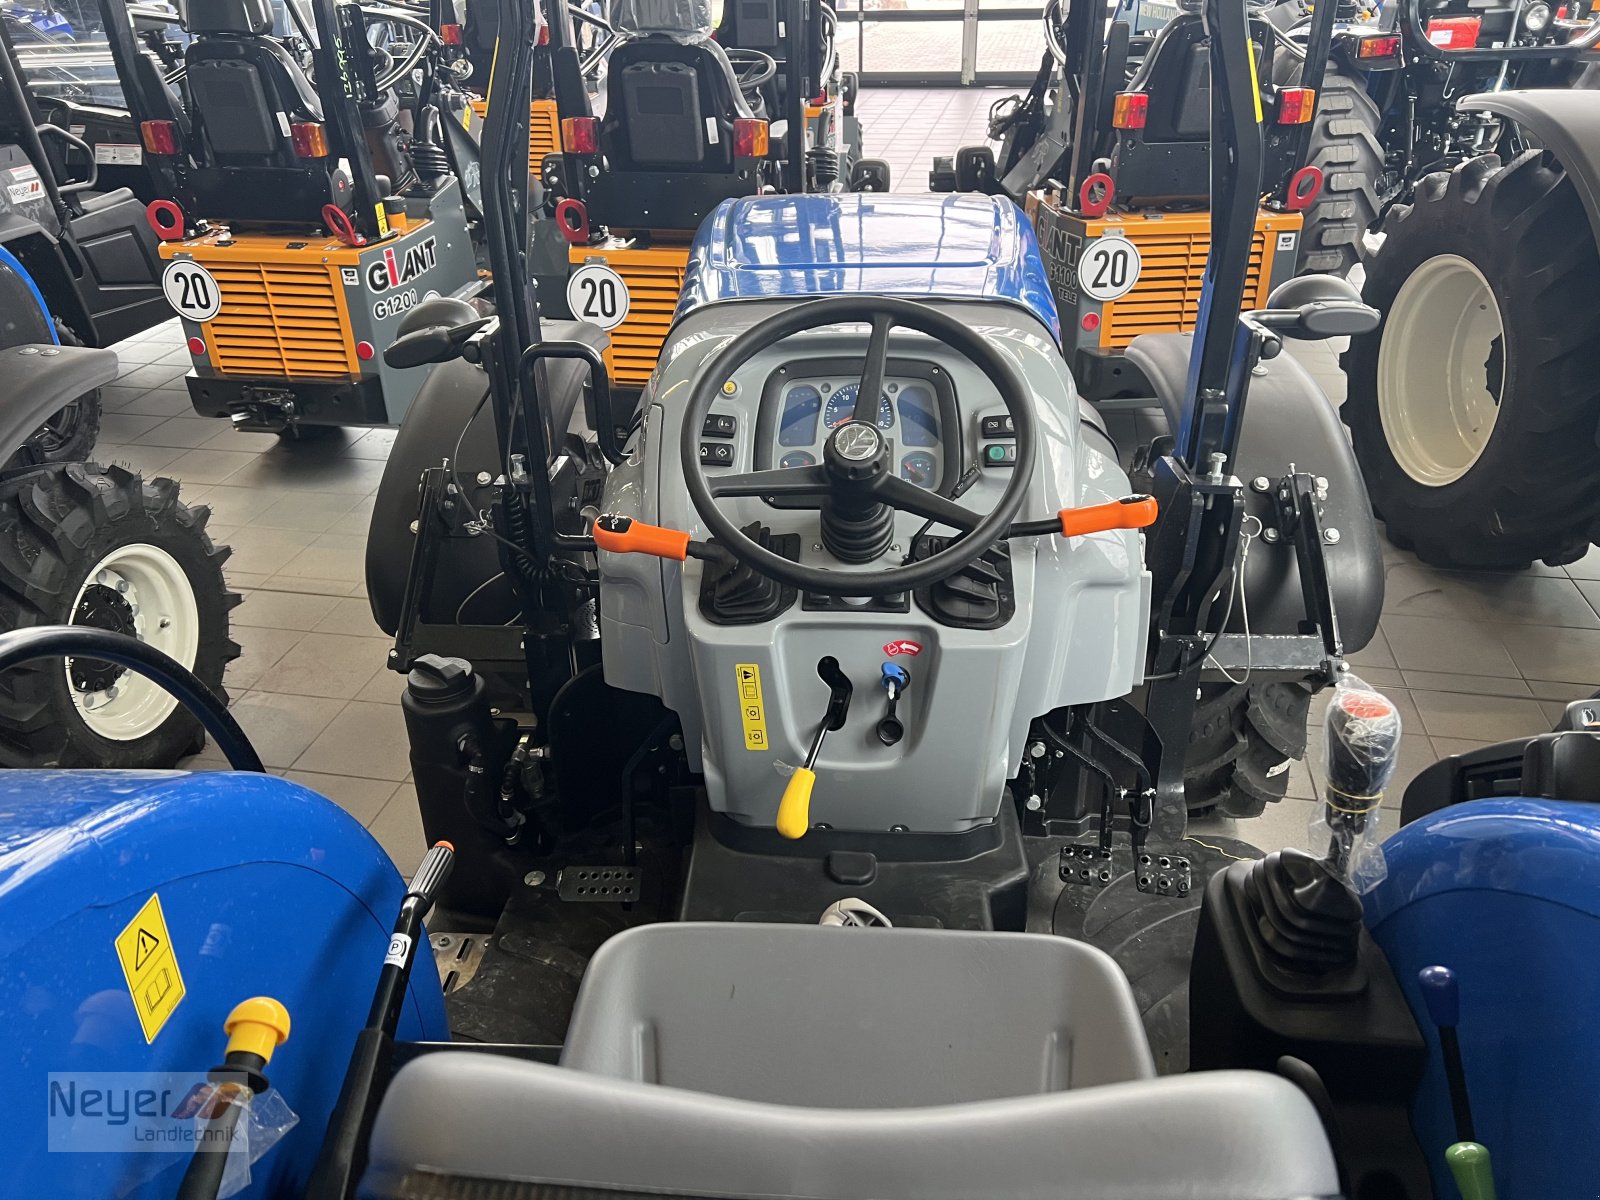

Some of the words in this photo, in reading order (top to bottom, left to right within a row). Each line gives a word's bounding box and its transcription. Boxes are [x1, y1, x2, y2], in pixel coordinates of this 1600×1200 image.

[1091, 249, 1129, 289] 20
[174, 272, 211, 310] 20
[373, 288, 418, 320] G1200
[581, 277, 617, 318] 20
[1058, 287, 1078, 305] TELE
[390, 943, 400, 952] P
